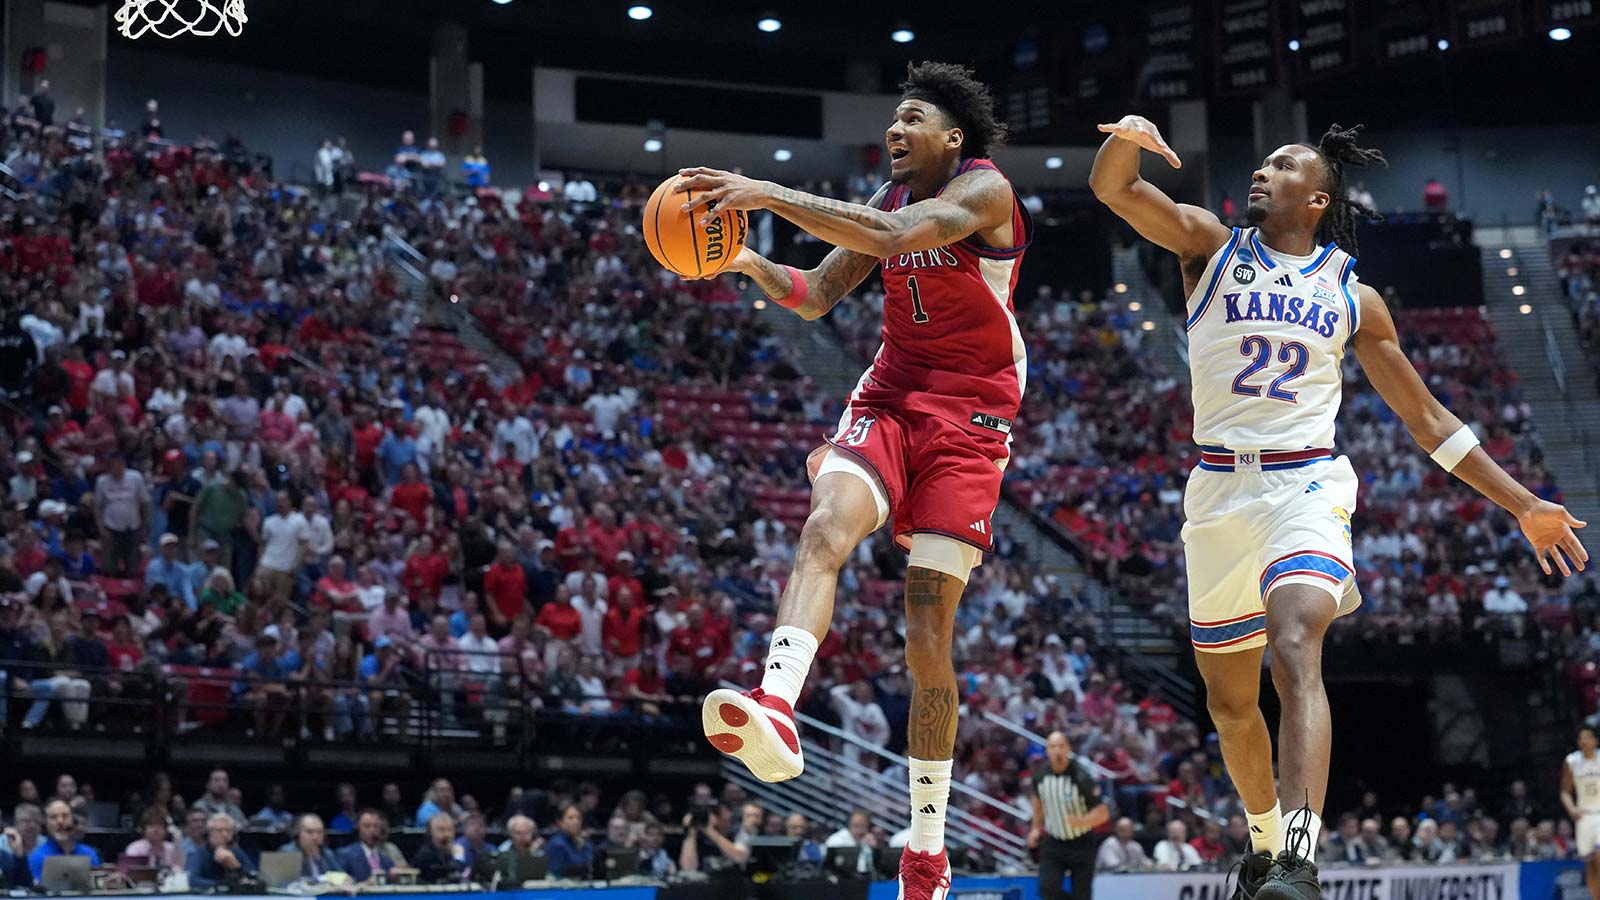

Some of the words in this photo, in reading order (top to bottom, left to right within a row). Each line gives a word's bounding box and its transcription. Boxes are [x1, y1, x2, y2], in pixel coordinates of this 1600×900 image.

[705, 198, 723, 262] Wils
[1235, 267, 1254, 281] SW
[907, 275, 929, 323] 1
[1223, 292, 1339, 338] KANSAS
[1231, 335, 1310, 403] 22
[1239, 454, 1255, 465] KU
